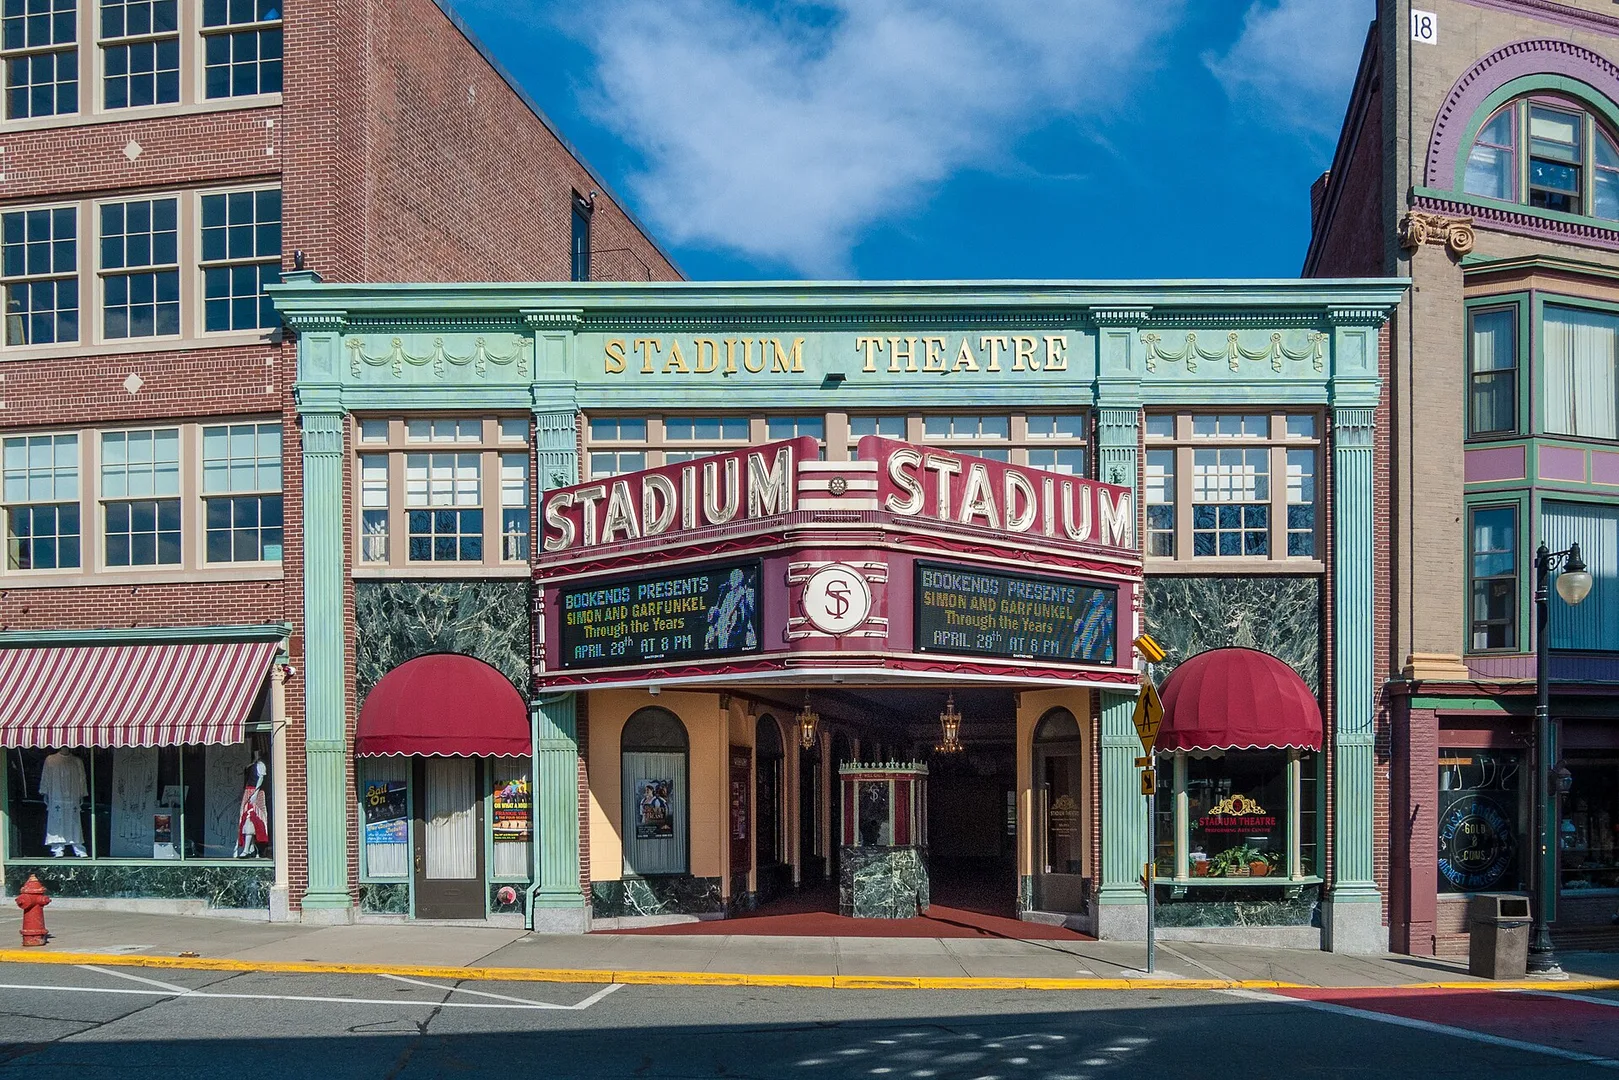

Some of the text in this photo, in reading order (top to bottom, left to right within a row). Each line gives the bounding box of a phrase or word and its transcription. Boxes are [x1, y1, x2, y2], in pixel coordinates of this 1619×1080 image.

[1414, 14, 1432, 39] 18
[604, 336, 1068, 374] STADIUM THEATRE
[543, 445, 793, 551] STADIUM
[885, 448, 1133, 549] STADIUM
[565, 576, 709, 609] BOOKENDS PRESENTS
[922, 570, 1075, 604] BOOKENDS PRESENTS
[567, 596, 707, 626] SIMON AND GARFUNKEL
[923, 591, 1073, 620] SIMON AND GARFUNKEL
[584, 617, 685, 639] Through the Years
[945, 610, 1053, 634] Through the Years
[574, 634, 692, 659] APRIL 28th AT 8 PM
[933, 630, 1060, 654] APRIL 28th AT 8 PM
[367, 784, 387, 797] Sail
[370, 795, 386, 806] On
[1199, 817, 1276, 826] STADIUM THEATRE
[1443, 809, 1464, 839] CASH
[1464, 823, 1485, 834] GOLD
[1463, 850, 1485, 861] COINS
[1439, 858, 1465, 885] HIGHEST
